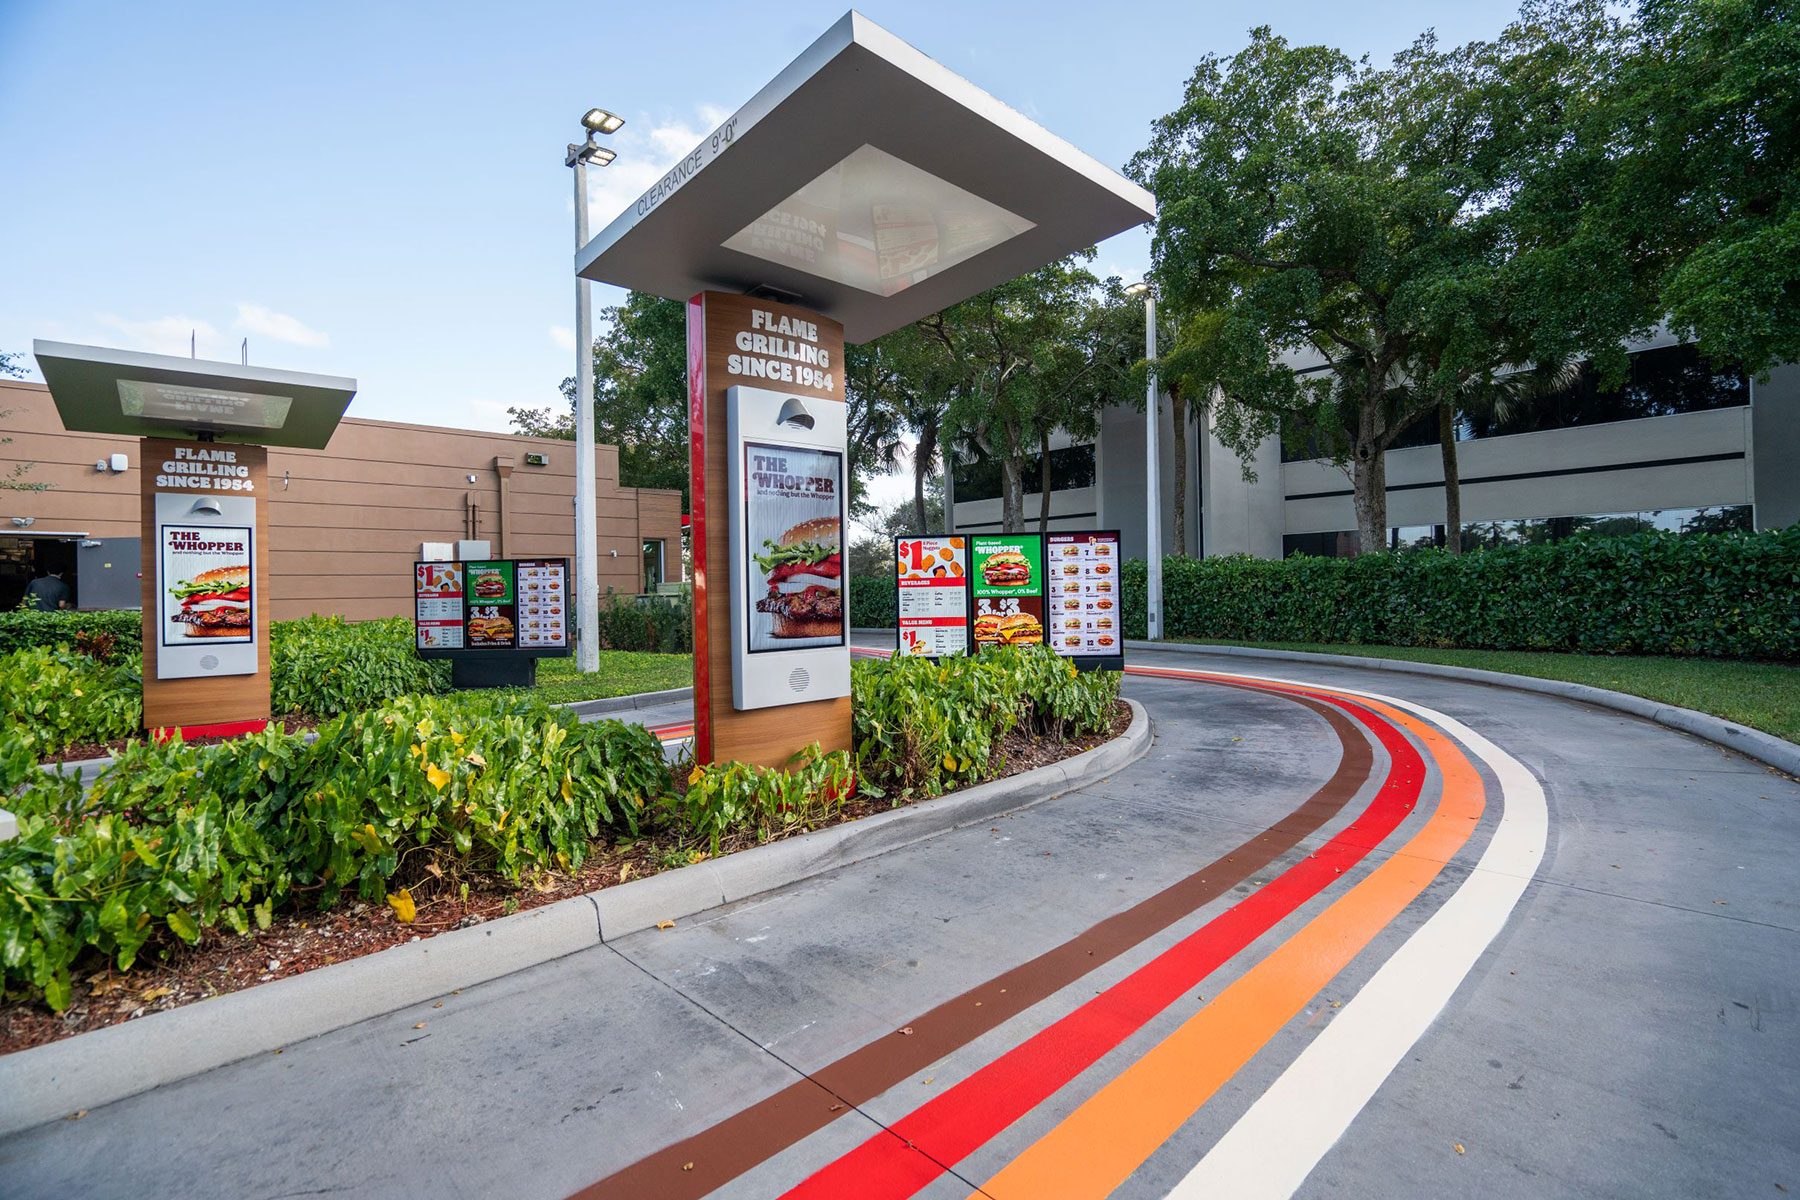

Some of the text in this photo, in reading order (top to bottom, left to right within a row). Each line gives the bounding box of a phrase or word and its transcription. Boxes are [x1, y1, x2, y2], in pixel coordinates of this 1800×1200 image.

[637, 149, 703, 216] CLEARANCE
[751, 309, 818, 342] FLAME
[736, 331, 829, 368] GRILLING
[727, 354, 834, 392] SINCE 1954
[175, 448, 237, 463] FLAME
[753, 455, 788, 473] THE
[162, 461, 249, 478] GRILLING
[156, 475, 255, 492] SINCE 1954
[752, 472, 834, 493] WHOPPER
[768, 490, 790, 498] nothing
[810, 492, 835, 501] Whopper
[170, 532, 200, 540] THE
[168, 541, 244, 551] WHOPPER
[900, 541, 922, 570] $1
